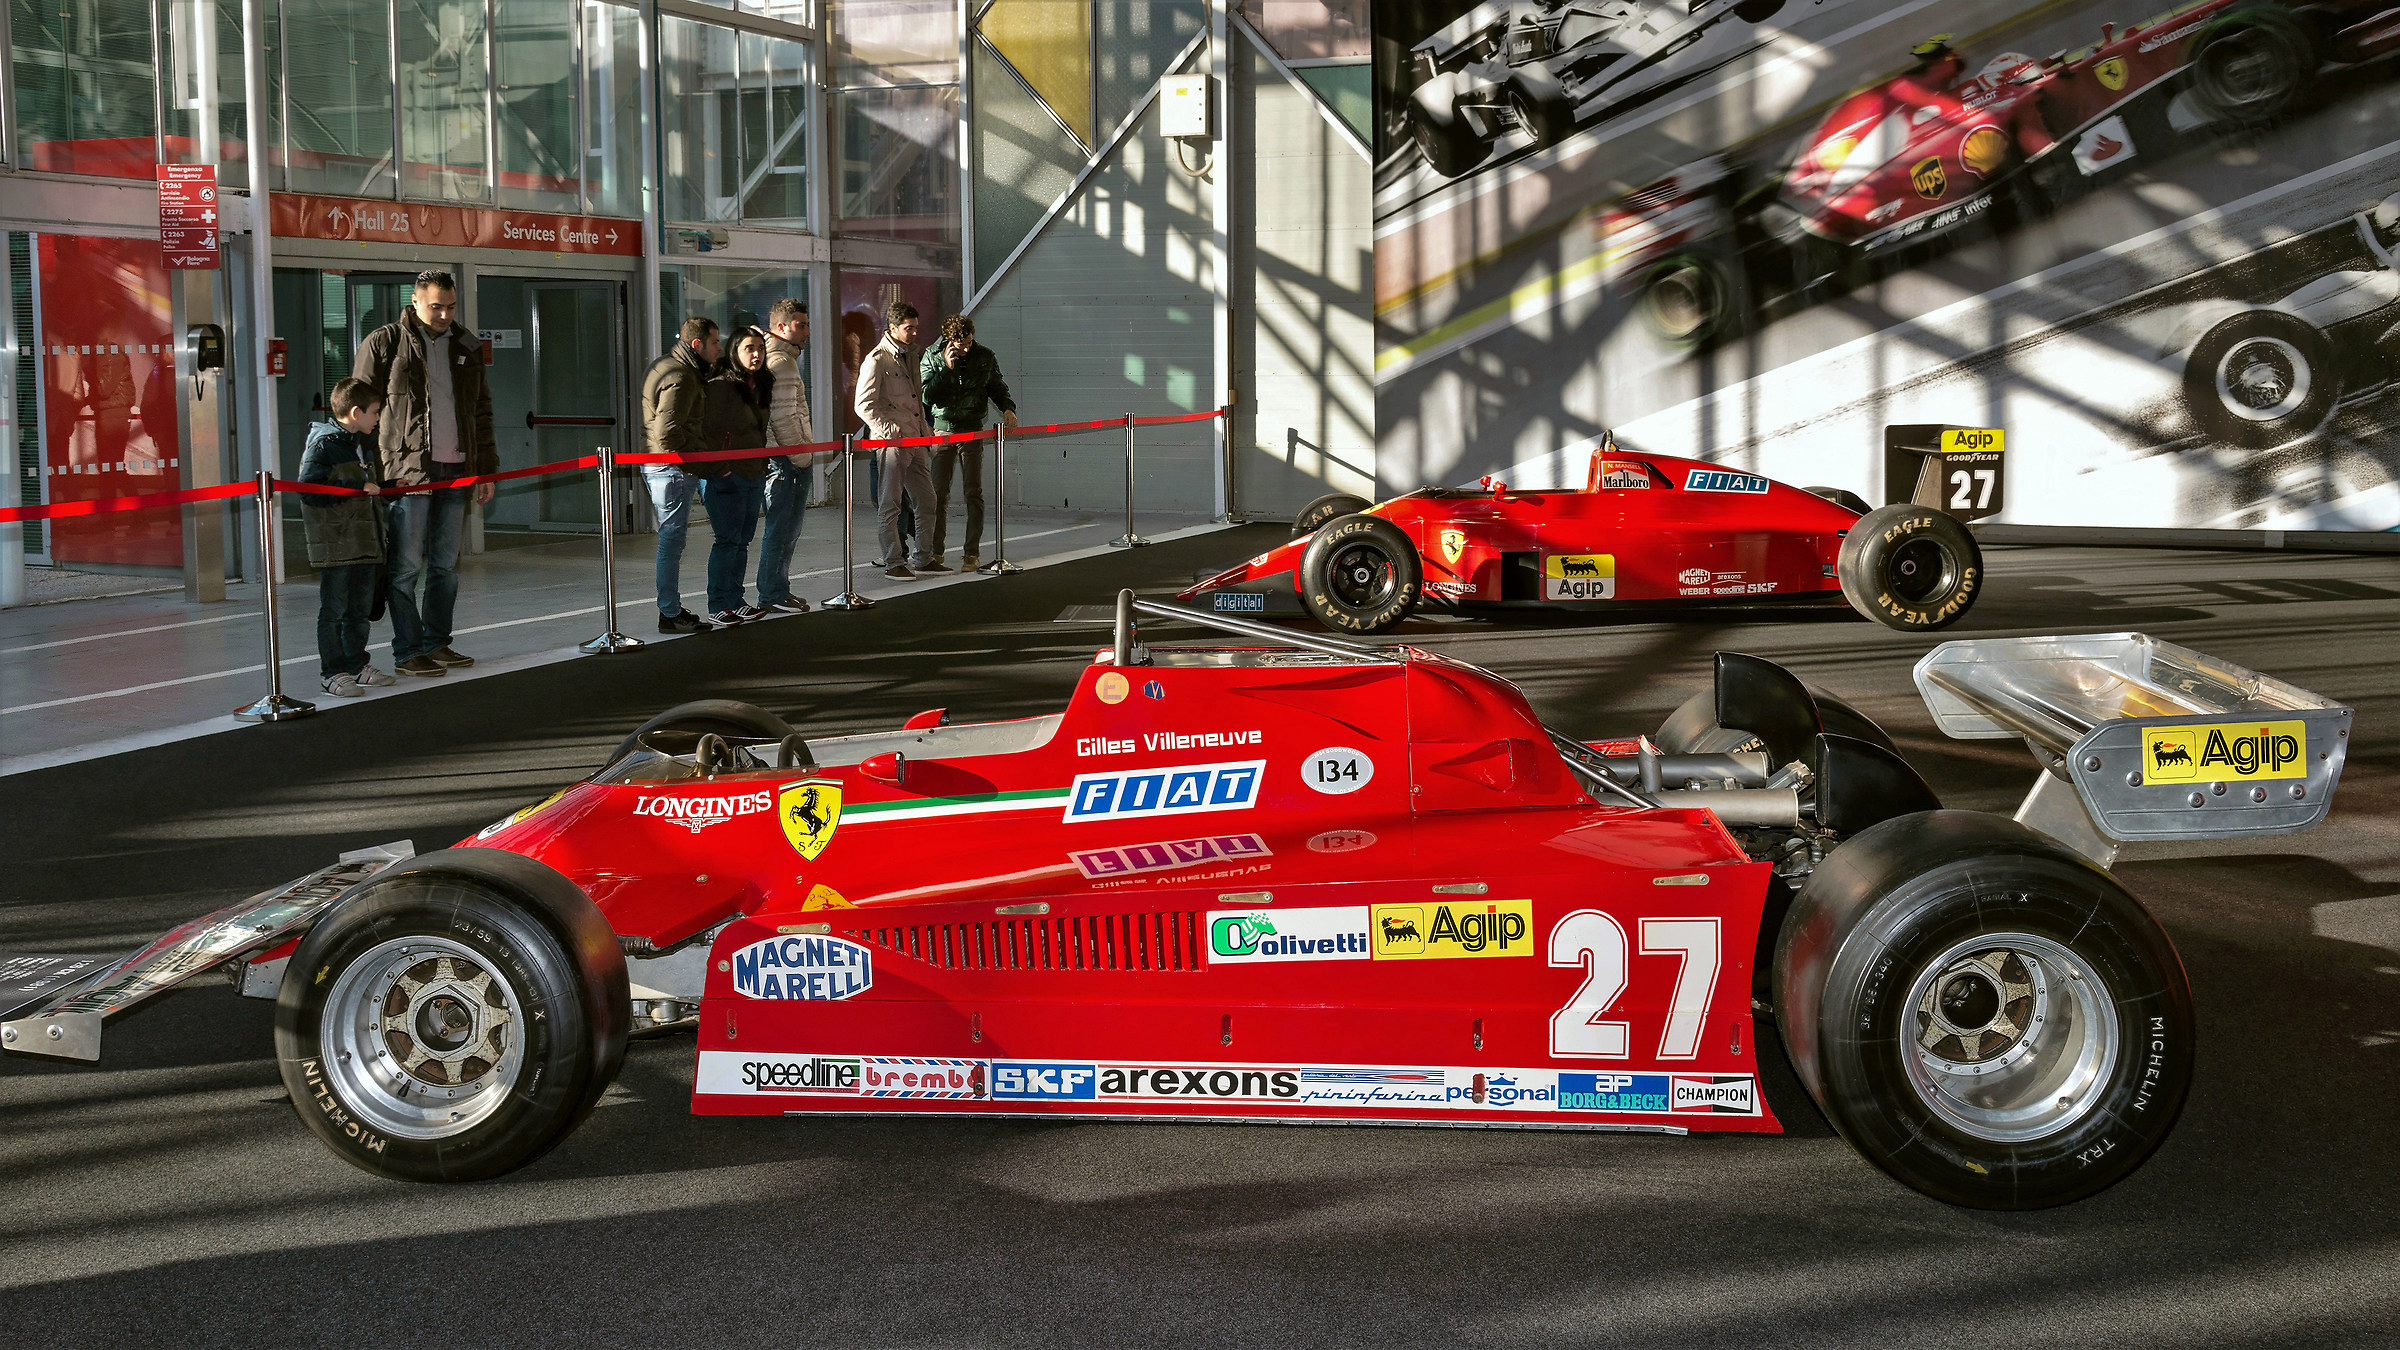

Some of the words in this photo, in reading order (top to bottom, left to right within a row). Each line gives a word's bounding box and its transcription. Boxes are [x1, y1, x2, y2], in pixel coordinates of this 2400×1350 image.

[1962, 90, 1997, 111] HUBLOT
[1914, 166, 1944, 195] ups
[1964, 194, 1993, 216] infor
[354, 211, 385, 231] Hall
[390, 213, 410, 233] 25
[503, 221, 556, 242] Services
[560, 225, 599, 245] Centre
[1954, 430, 1993, 449] Agip
[1603, 471, 1649, 488] Marlboro
[1691, 472, 1766, 490] FIAT
[1950, 469, 1995, 509] 27
[1326, 523, 1374, 545] EAGLE
[1884, 517, 1933, 543] EAGLE
[1424, 581, 1477, 593] LONGINES
[1557, 579, 1604, 598] Agip
[1679, 587, 1710, 596] WEBER
[1747, 582, 1778, 594] SKF
[1215, 597, 1261, 609] digital
[1077, 736, 1136, 757] Gilles
[1143, 730, 1263, 752] Villeneuve
[2199, 728, 2299, 775] Agip
[1317, 758, 1359, 783] 134
[633, 790, 773, 817] LONGINES
[1080, 770, 1255, 813] FIAT
[1427, 905, 1525, 952] Agip
[736, 937, 872, 975] MAGNETI
[1261, 933, 1367, 956] olivetti
[736, 962, 872, 1000] MARELLI
[1547, 908, 1722, 1061] 27
[742, 1058, 856, 1092] speedline
[2133, 1016, 2165, 1113] MICHELIN
[995, 1068, 1093, 1093] SKF
[1101, 1067, 1300, 1097] arexons
[301, 1060, 387, 1154] MICHELIN
[1301, 1087, 1444, 1104] pininfarina
[1560, 1092, 1667, 1111] BORG&BECK
[1676, 1087, 1748, 1102] CHAMPION
[2076, 1137, 2116, 1167] TRX
